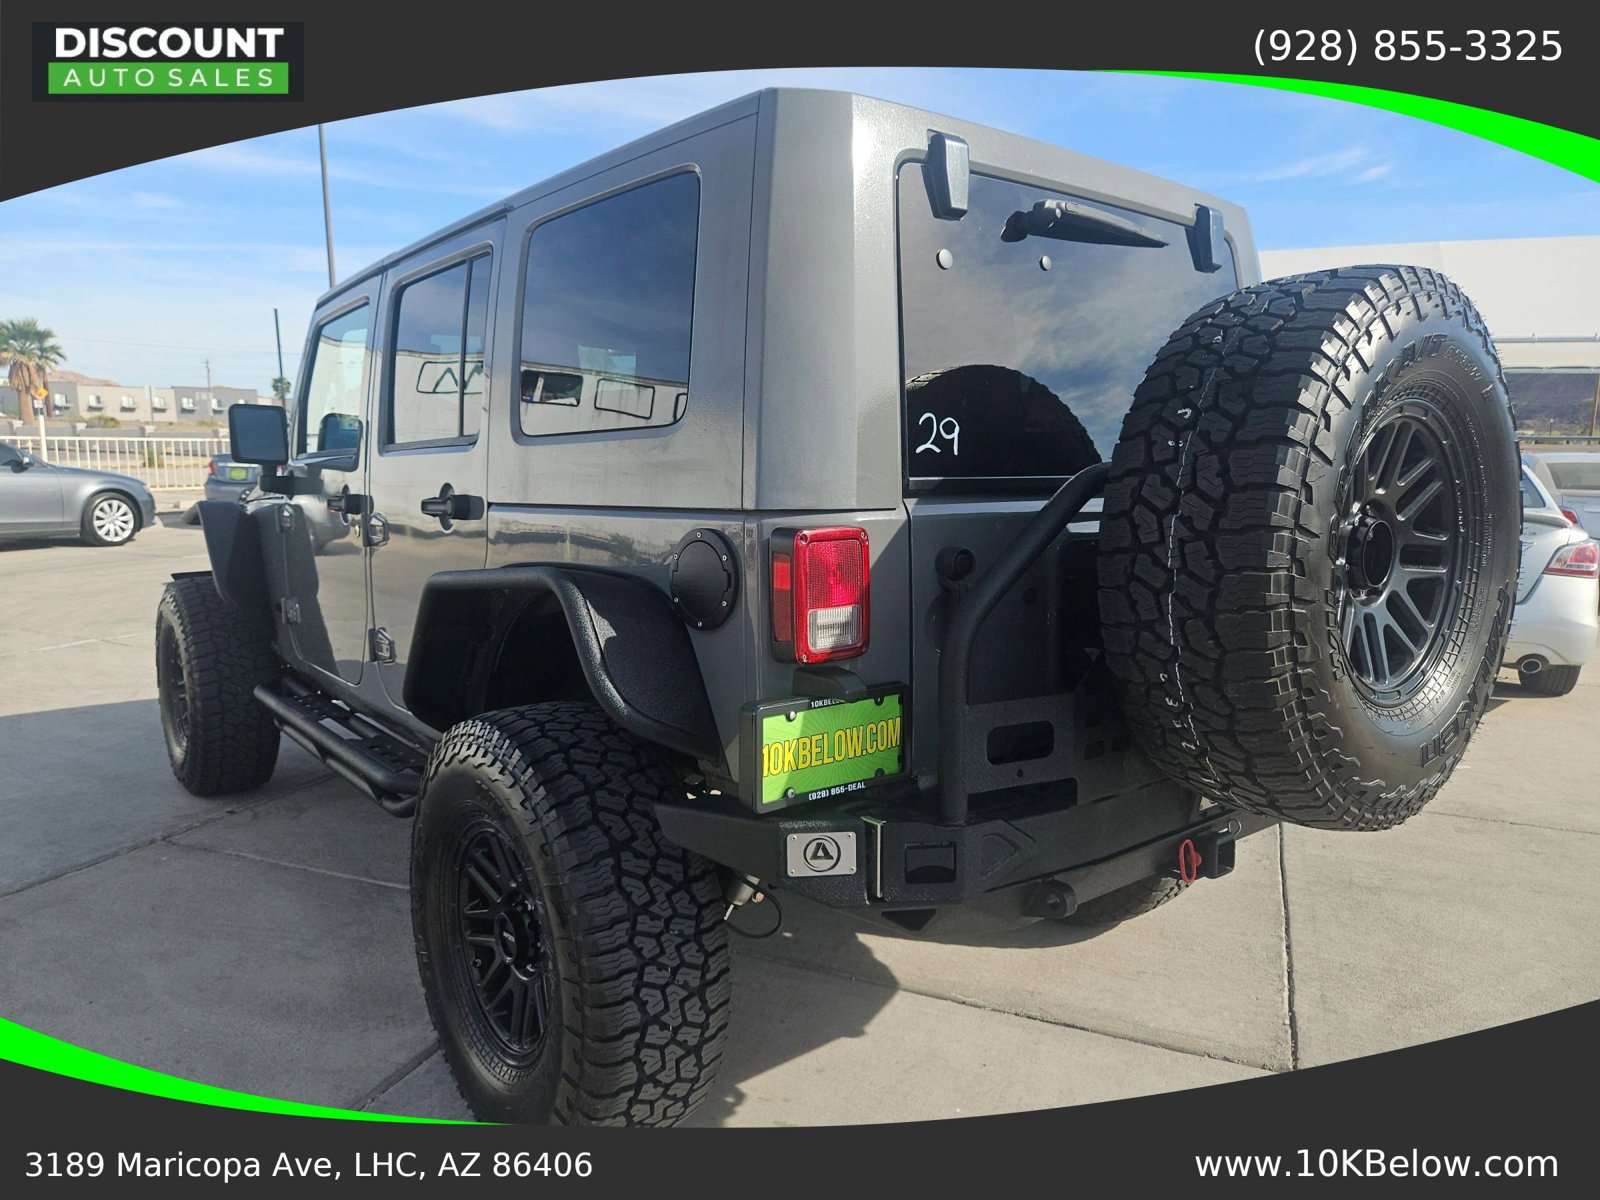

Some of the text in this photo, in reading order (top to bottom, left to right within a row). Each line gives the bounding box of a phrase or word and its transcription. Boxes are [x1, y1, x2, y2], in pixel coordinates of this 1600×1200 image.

[915, 412, 960, 456] 29
[762, 717, 901, 777] 10KBELOW.COM
[831, 782, 866, 795] 855-DEAL
